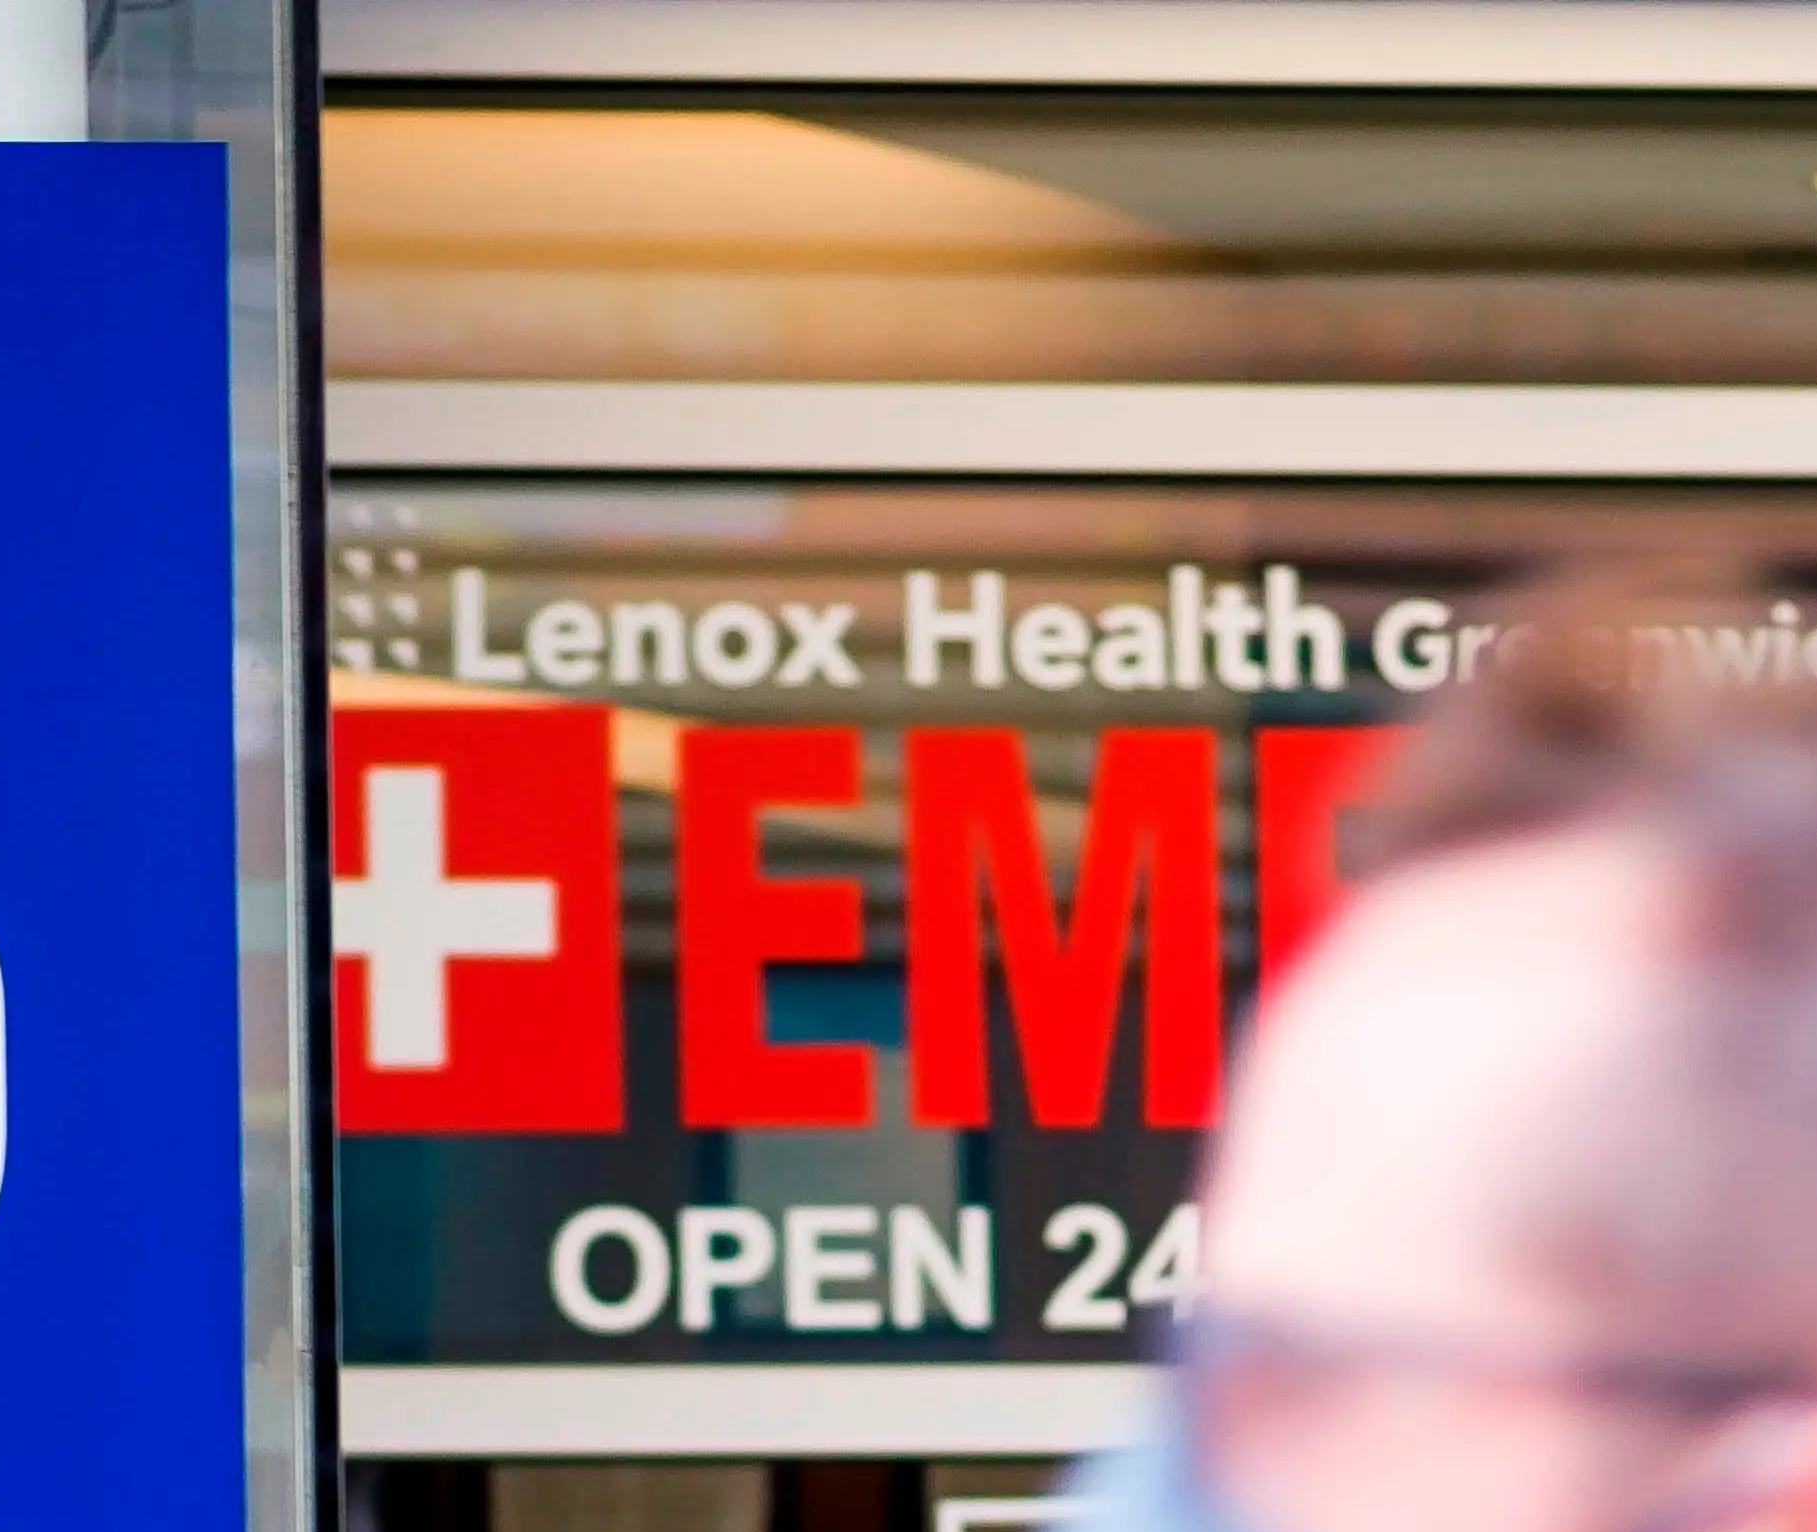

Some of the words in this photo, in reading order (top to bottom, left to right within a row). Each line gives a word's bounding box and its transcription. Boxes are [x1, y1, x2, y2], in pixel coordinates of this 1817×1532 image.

[450, 566, 864, 688] Lenox
[903, 564, 1348, 692] Health
[549, 1202, 992, 1333] OPEN
[1040, 1202, 1206, 1331] 24
